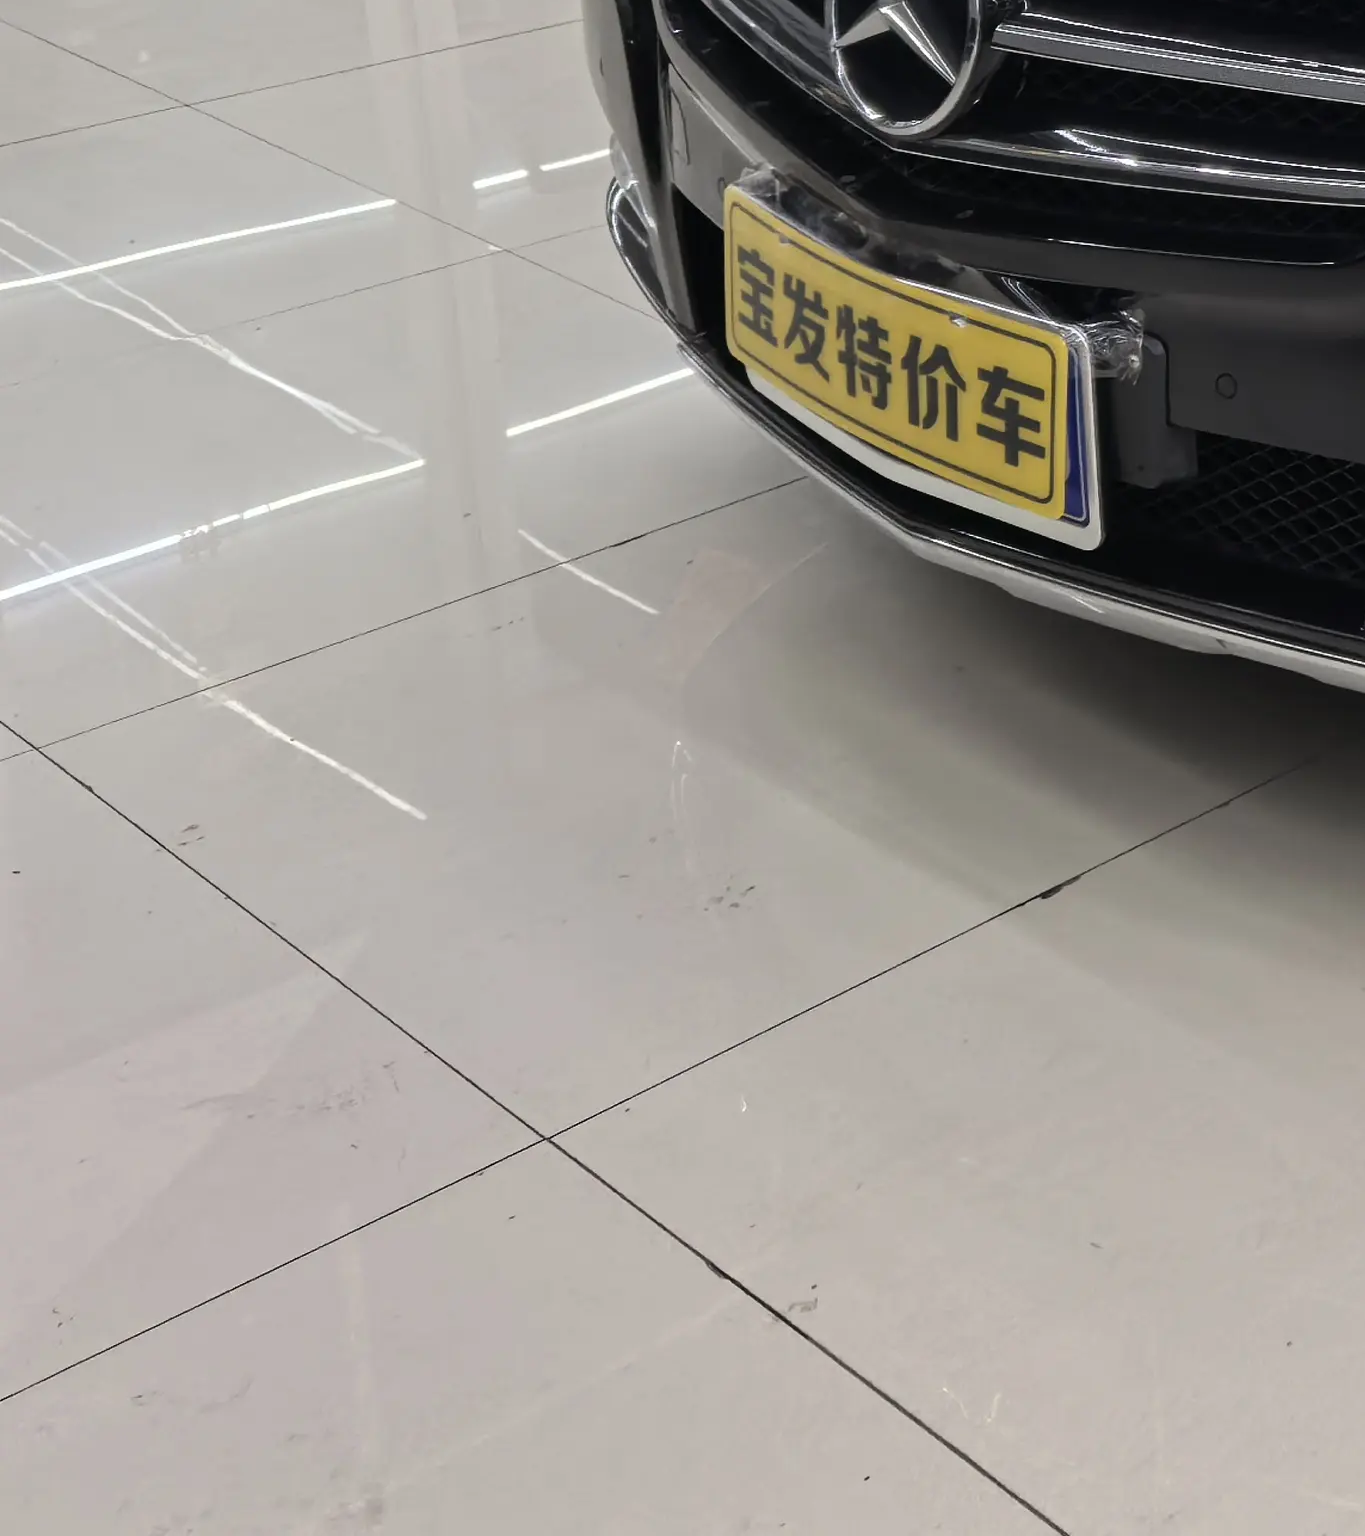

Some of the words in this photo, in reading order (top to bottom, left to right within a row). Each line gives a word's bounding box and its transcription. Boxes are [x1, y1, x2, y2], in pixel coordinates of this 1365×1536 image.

[737, 244, 1047, 468] 宝发特价车
